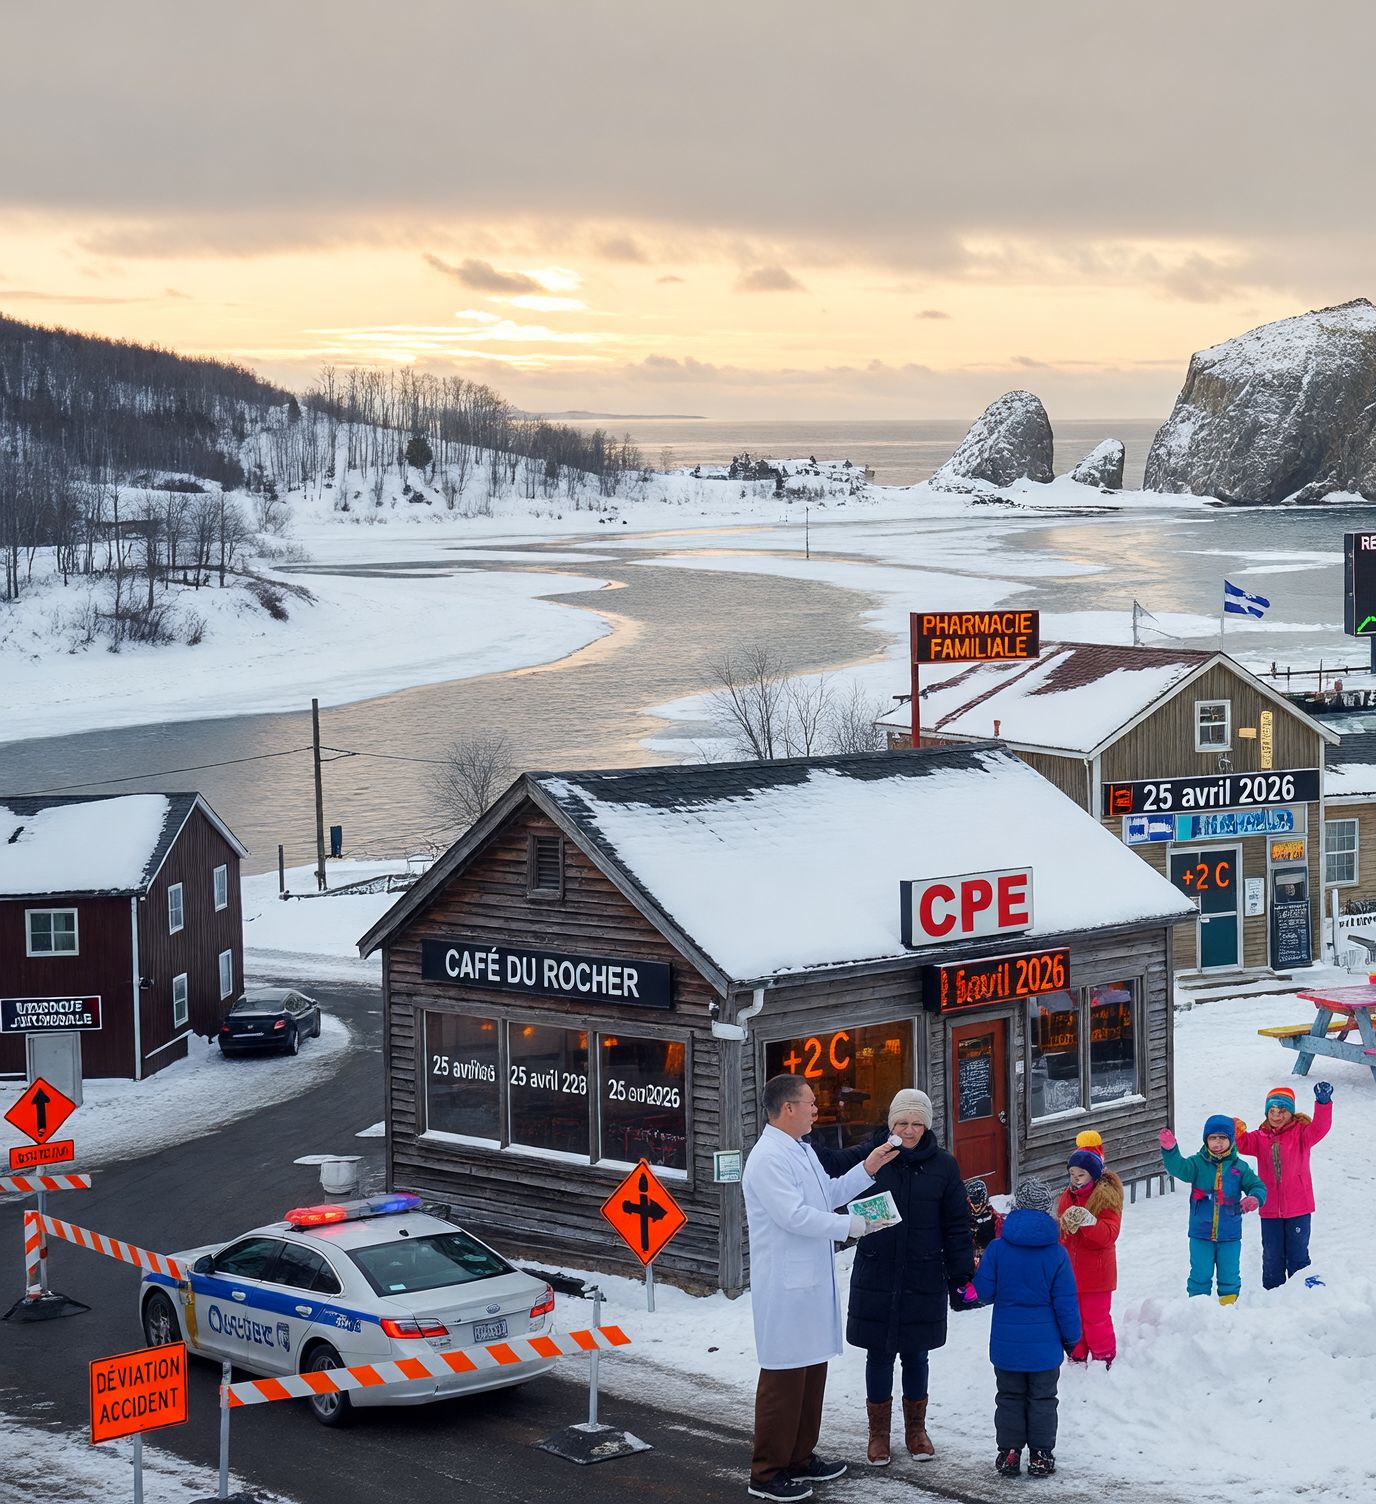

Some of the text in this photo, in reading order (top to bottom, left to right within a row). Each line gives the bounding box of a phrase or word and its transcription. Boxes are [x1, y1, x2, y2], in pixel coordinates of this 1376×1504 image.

[922, 613, 1033, 635] PHARMACIE
[930, 636, 1028, 659] FAMILIALE
[1143, 784, 1173, 811] 25
[1181, 778, 1231, 807] avril
[1239, 774, 1295, 804] 2026
[1182, 861, 1230, 890] +2 C
[919, 873, 1029, 937] CPE
[445, 946, 640, 998] CAFÉ DU ROCHER
[1015, 953, 1065, 995] 2026
[432, 1055, 449, 1076] 25
[783, 1031, 850, 1078] +2 C
[510, 1065, 527, 1086] 25
[530, 1069, 559, 1091] avril
[96, 1355, 180, 1394] DÉVIATION
[100, 1387, 179, 1425] ACCIDENT
